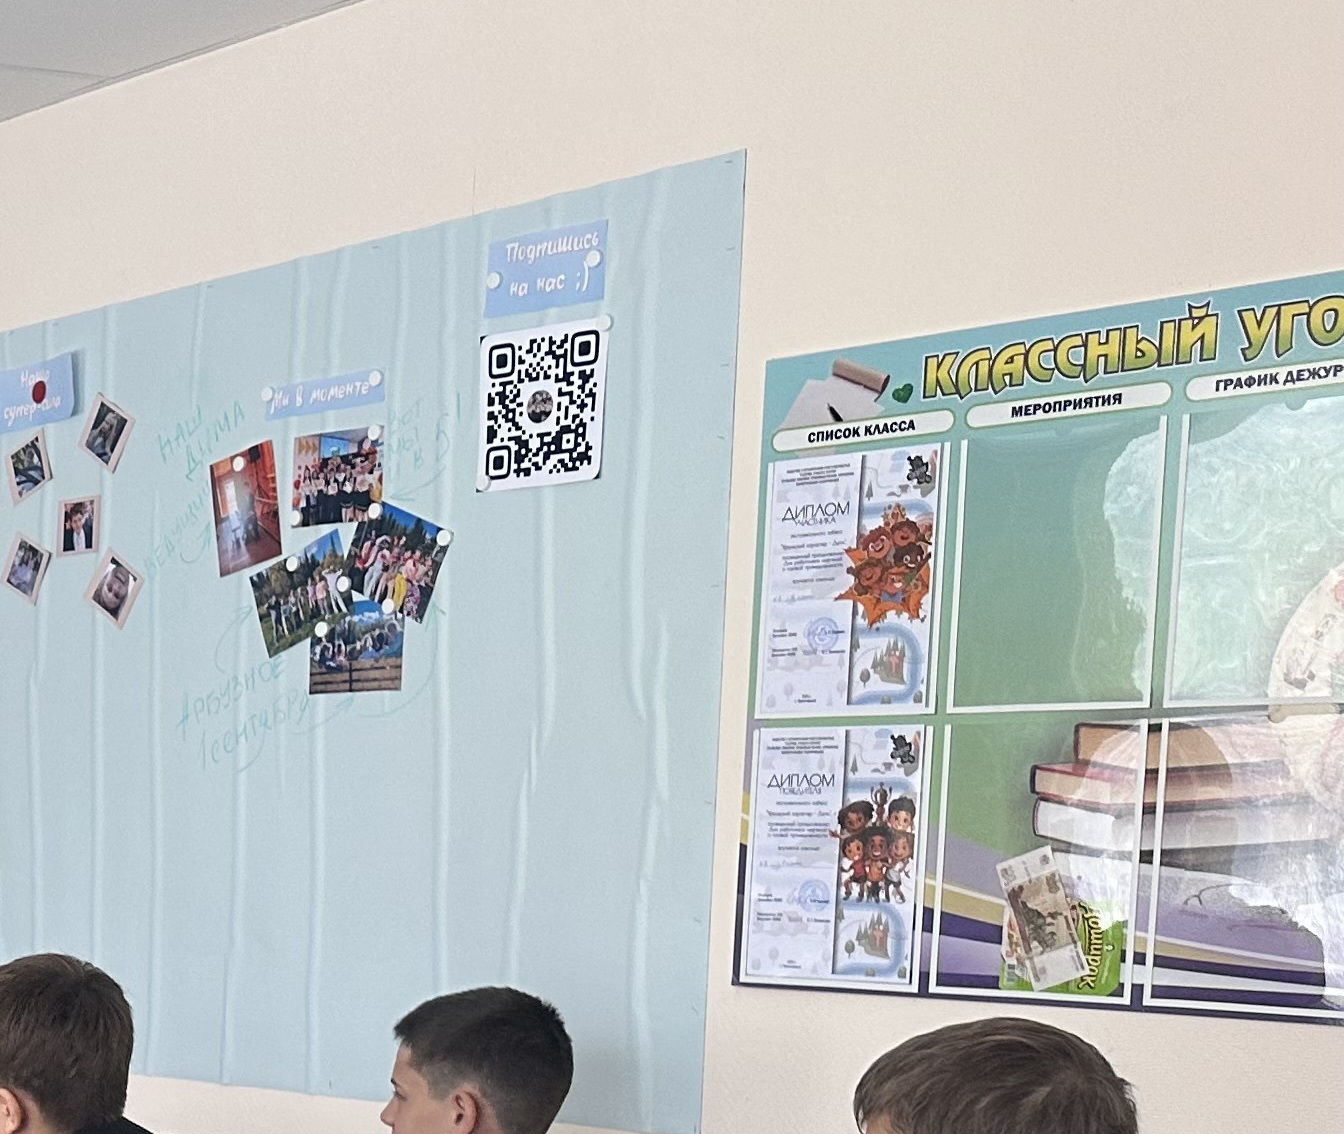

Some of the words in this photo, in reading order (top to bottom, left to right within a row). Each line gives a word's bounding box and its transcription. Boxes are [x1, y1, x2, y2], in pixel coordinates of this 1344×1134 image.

[506, 231, 599, 265] Подпишись
[510, 281, 529, 297] на
[537, 274, 566, 293] нас
[922, 300, 1219, 399] КЛАССНЫЙ
[1238, 294, 1344, 361] УГО
[1215, 371, 1280, 392] ГРАФИК
[1283, 364, 1344, 386] ДЕЖУР
[310, 381, 369, 404] моменте
[1011, 392, 1123, 418] МЕРОПРИЯТИЯ
[807, 426, 861, 443] СПИСОК
[864, 419, 916, 436] КЛАССА
[781, 500, 850, 522] ДИПЛОМ
[767, 773, 835, 788] ДИПЛОМ
